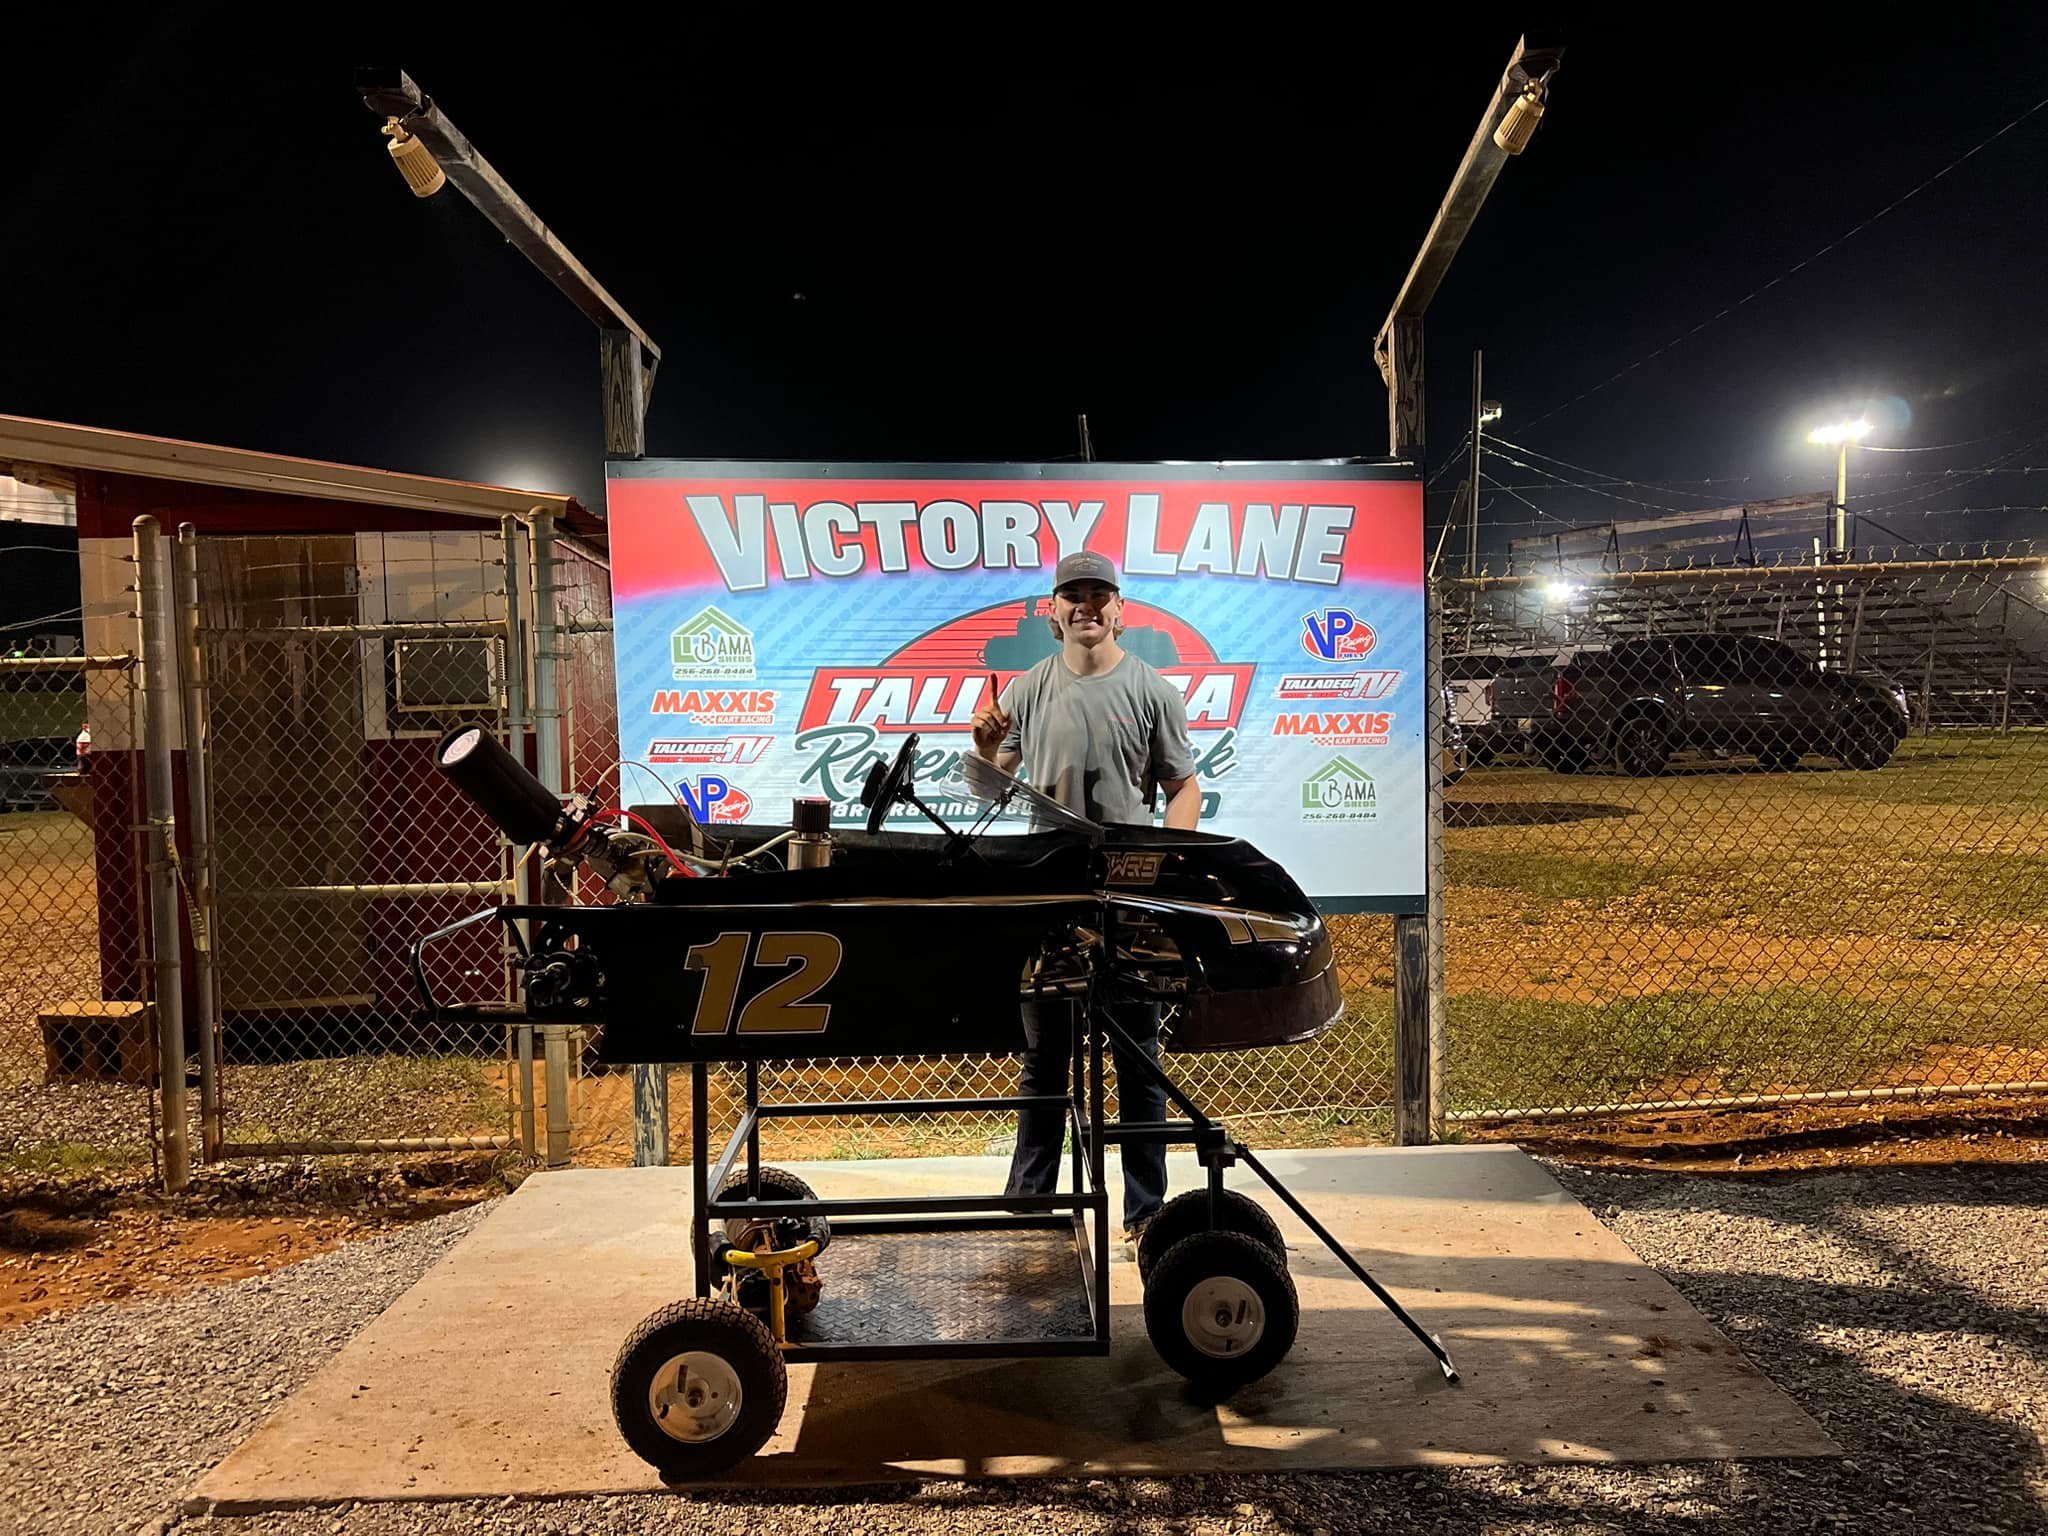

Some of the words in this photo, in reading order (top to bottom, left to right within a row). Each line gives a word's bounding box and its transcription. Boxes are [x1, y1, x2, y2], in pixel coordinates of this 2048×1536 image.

[684, 493, 1104, 592] VICTORY
[1123, 493, 1355, 586] LANE
[1306, 611, 1354, 659] VP
[652, 692, 775, 713] MAXXIS
[718, 715, 740, 724] KART
[741, 715, 772, 724] RACING
[1273, 713, 1390, 735] MAXXIS
[1335, 737, 1357, 745] KART
[1358, 736, 1386, 745] RACING
[678, 777, 728, 825] VP
[684, 931, 843, 1036] 12
